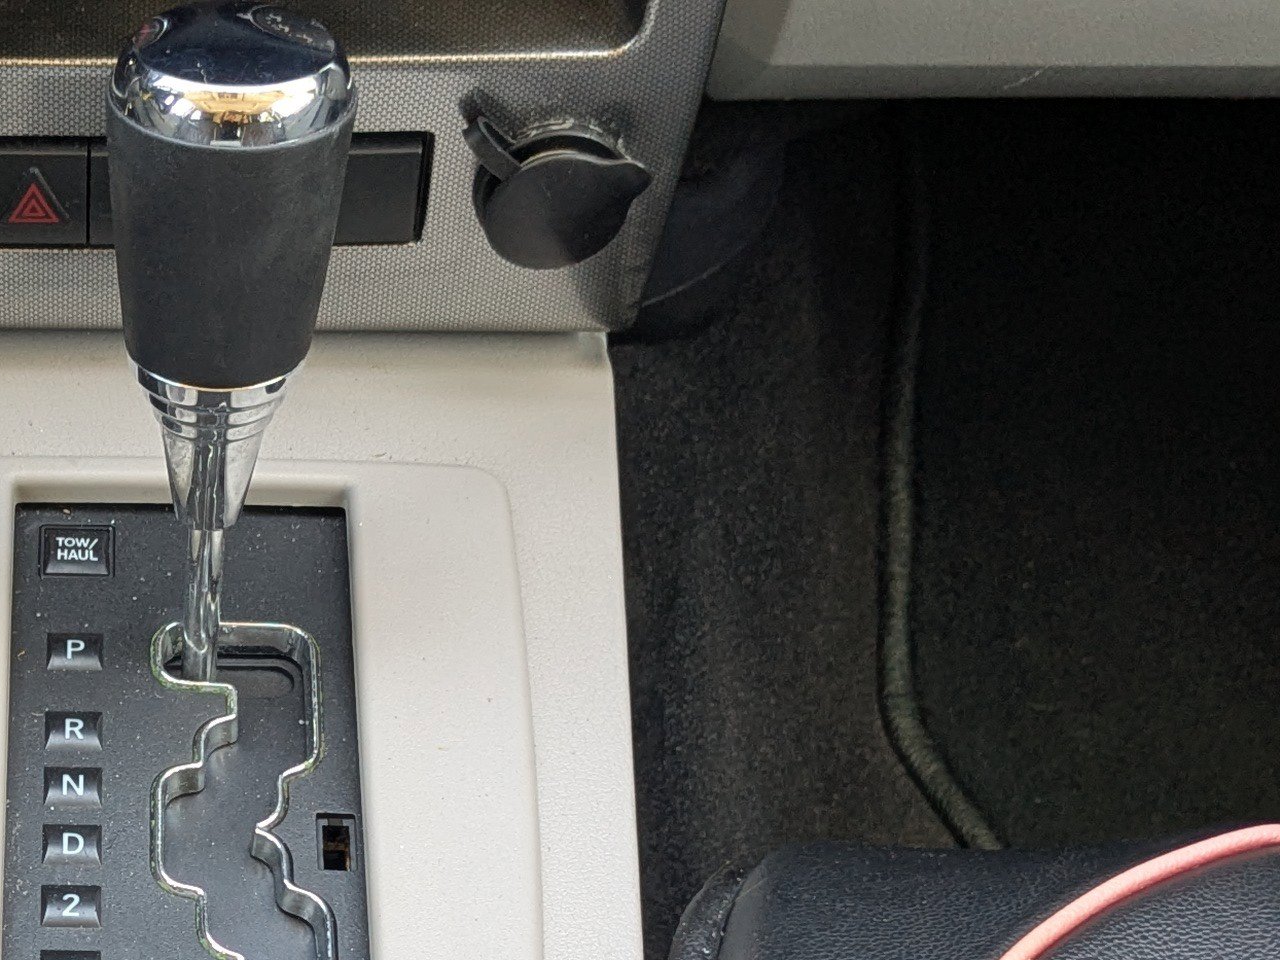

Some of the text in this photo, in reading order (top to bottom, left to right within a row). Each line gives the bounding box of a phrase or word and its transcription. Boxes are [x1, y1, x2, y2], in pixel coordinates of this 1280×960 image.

[55, 536, 99, 550] TOW/
[57, 548, 99, 562] HAUL
[66, 640, 85, 660] P
[64, 718, 84, 740] R
[63, 774, 84, 798] N
[62, 832, 85, 856] D
[61, 893, 81, 917] 2
